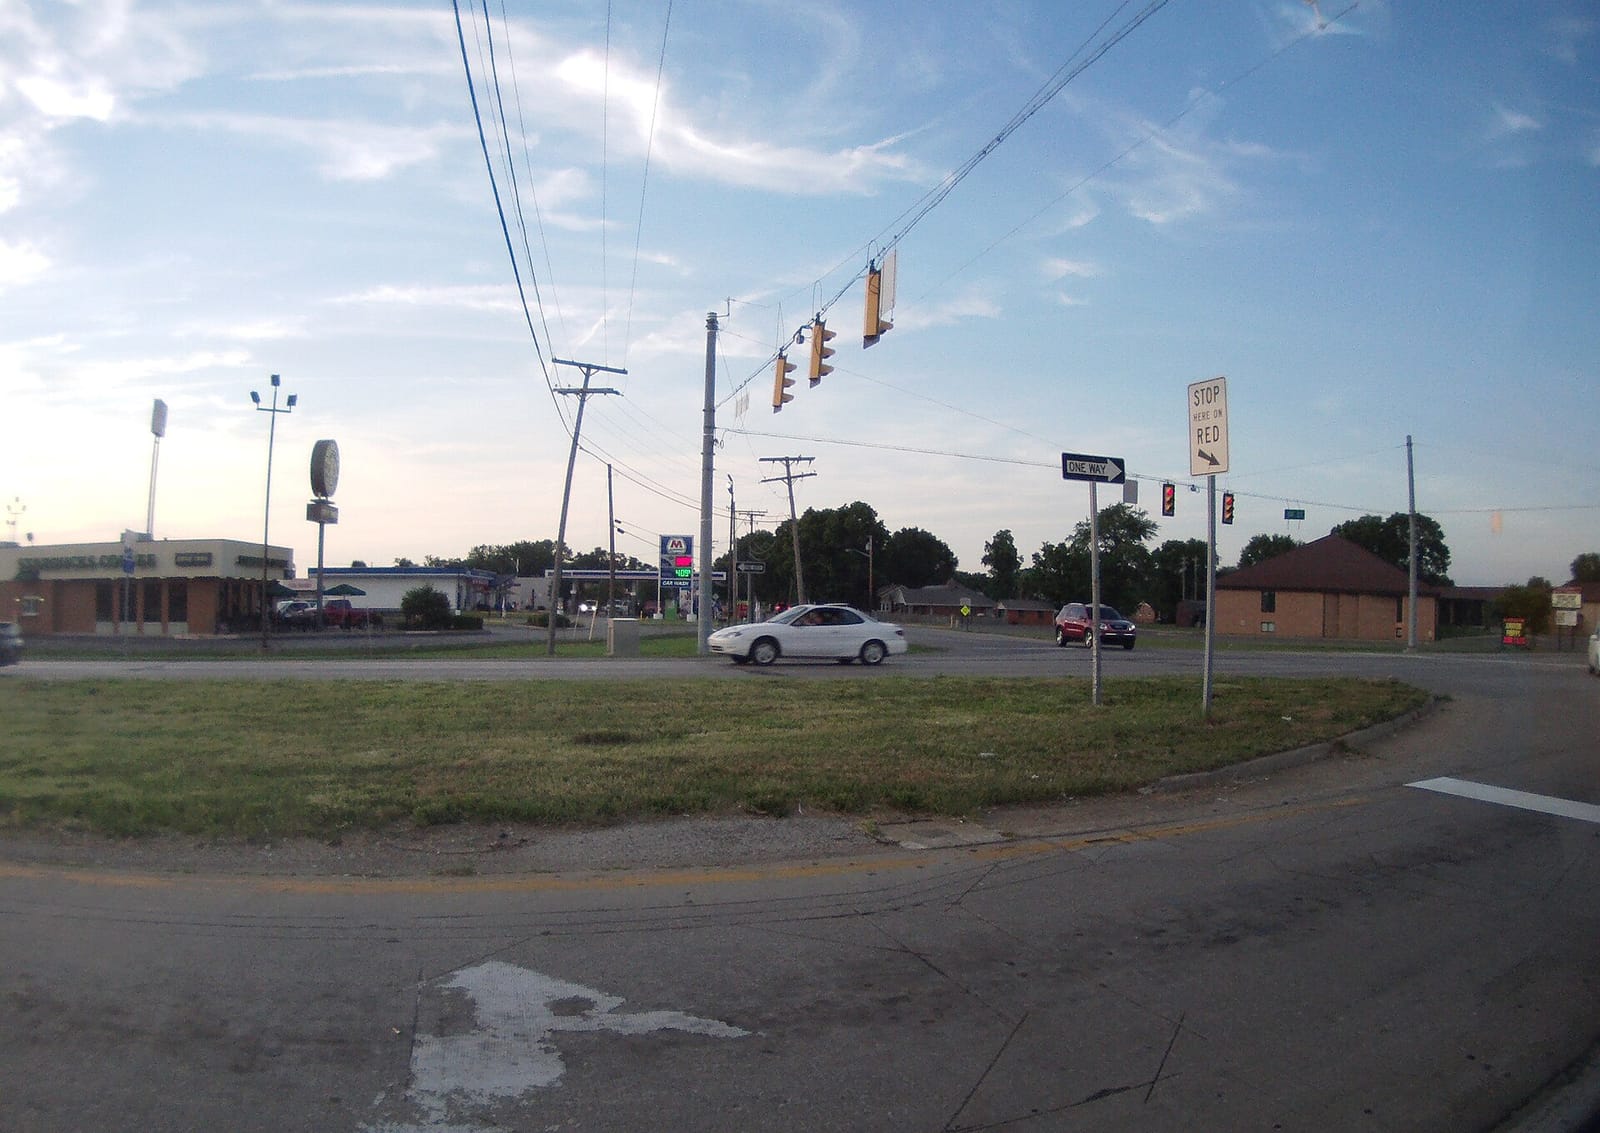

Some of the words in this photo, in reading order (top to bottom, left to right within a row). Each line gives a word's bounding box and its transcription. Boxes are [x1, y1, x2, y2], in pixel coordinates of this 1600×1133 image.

[1193, 385, 1220, 407] STOP
[1193, 410, 1211, 422] HERE
[1213, 408, 1223, 419] ON
[1197, 425, 1220, 445] RED
[1069, 461, 1087, 473] ONE
[1088, 463, 1106, 475] WAY
